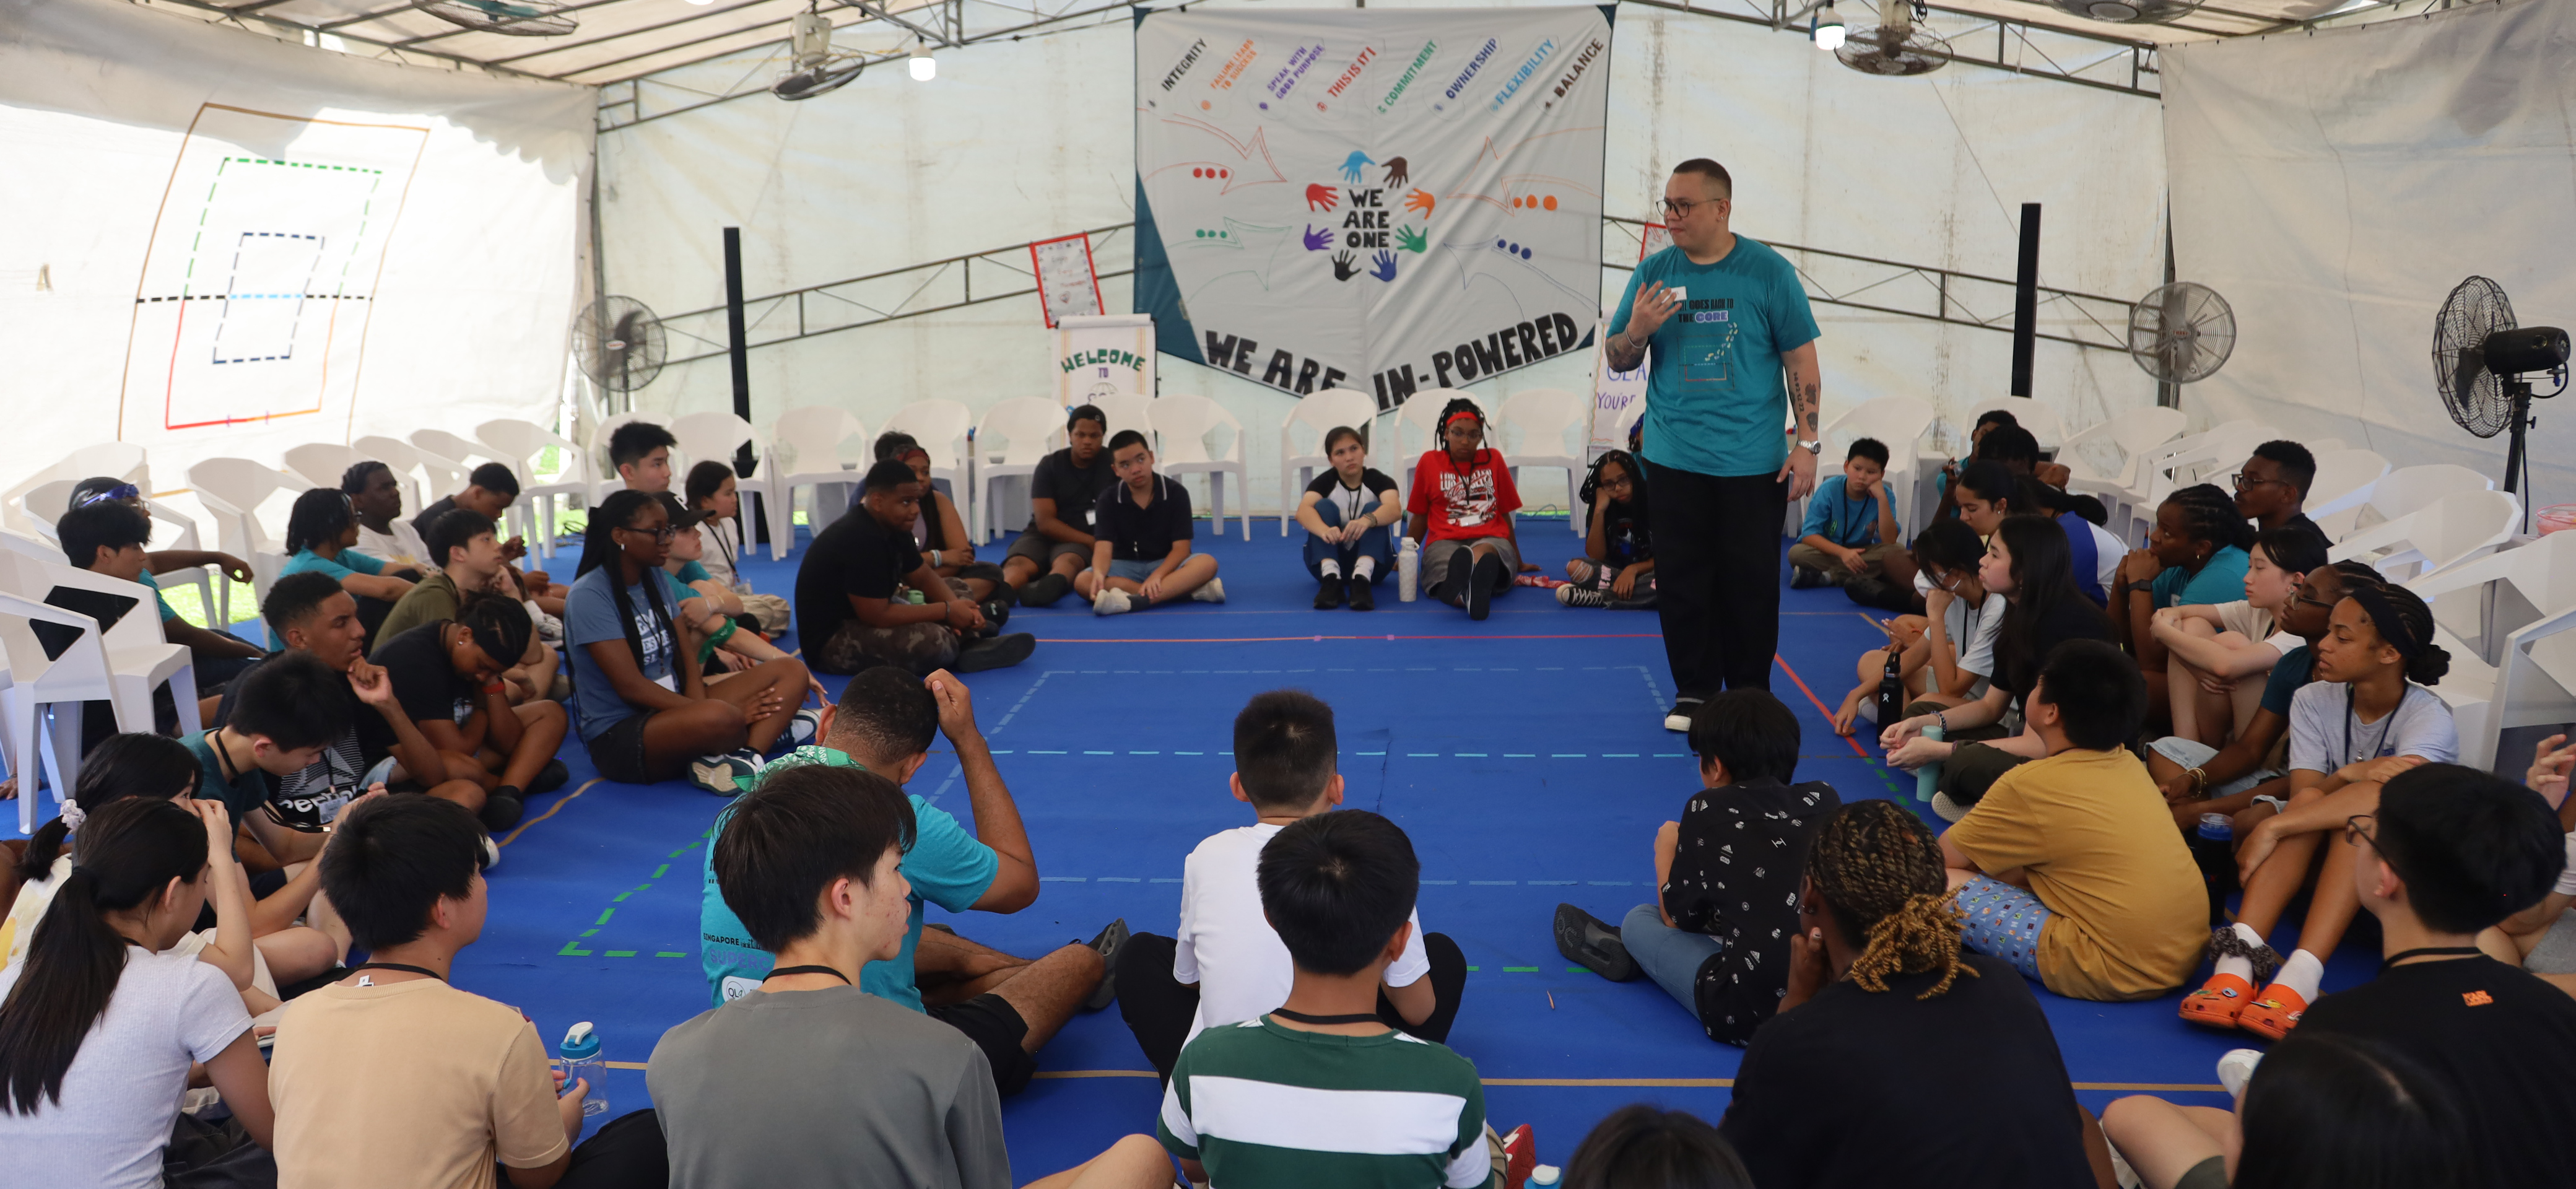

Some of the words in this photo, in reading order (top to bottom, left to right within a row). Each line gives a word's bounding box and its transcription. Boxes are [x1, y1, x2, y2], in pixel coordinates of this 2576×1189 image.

[1161, 37, 1208, 92] INTEGRITY
[1210, 61, 1234, 89] FAILURE
[1233, 38, 1255, 62] LEADS
[1221, 80, 1232, 90] TO
[1230, 50, 1258, 81] SUCCESS
[1268, 66, 1290, 92] SPEAK
[1288, 46, 1308, 66] WITH
[1276, 77, 1295, 100] GOOD
[1293, 43, 1325, 79] PURPOSE
[1327, 73, 1352, 98] THIS
[1347, 63, 1361, 78] IS
[1384, 38, 1438, 107] COMMITMENT
[1446, 37, 1497, 99] OWNERSHIP
[1495, 38, 1555, 105] FLEXIBILITY
[1553, 38, 1604, 98] BALANCE
[1348, 188, 1384, 207] WE
[1342, 211, 1390, 229] ARE
[1346, 231, 1390, 248] ONE
[1679, 313, 1694, 323] THE
[1695, 310, 1728, 323] CORE
[1689, 299, 1709, 310] GOES
[1711, 298, 1725, 310] BACK
[1727, 298, 1734, 309] TO
[1061, 349, 1146, 373] WELCOME
[1098, 367, 1108, 378] TO
[1206, 329, 1258, 375] WE
[1262, 348, 1347, 395] ARE
[1373, 311, 1578, 411] IN-POWERED
[703, 933, 739, 946] SINGAPORE
